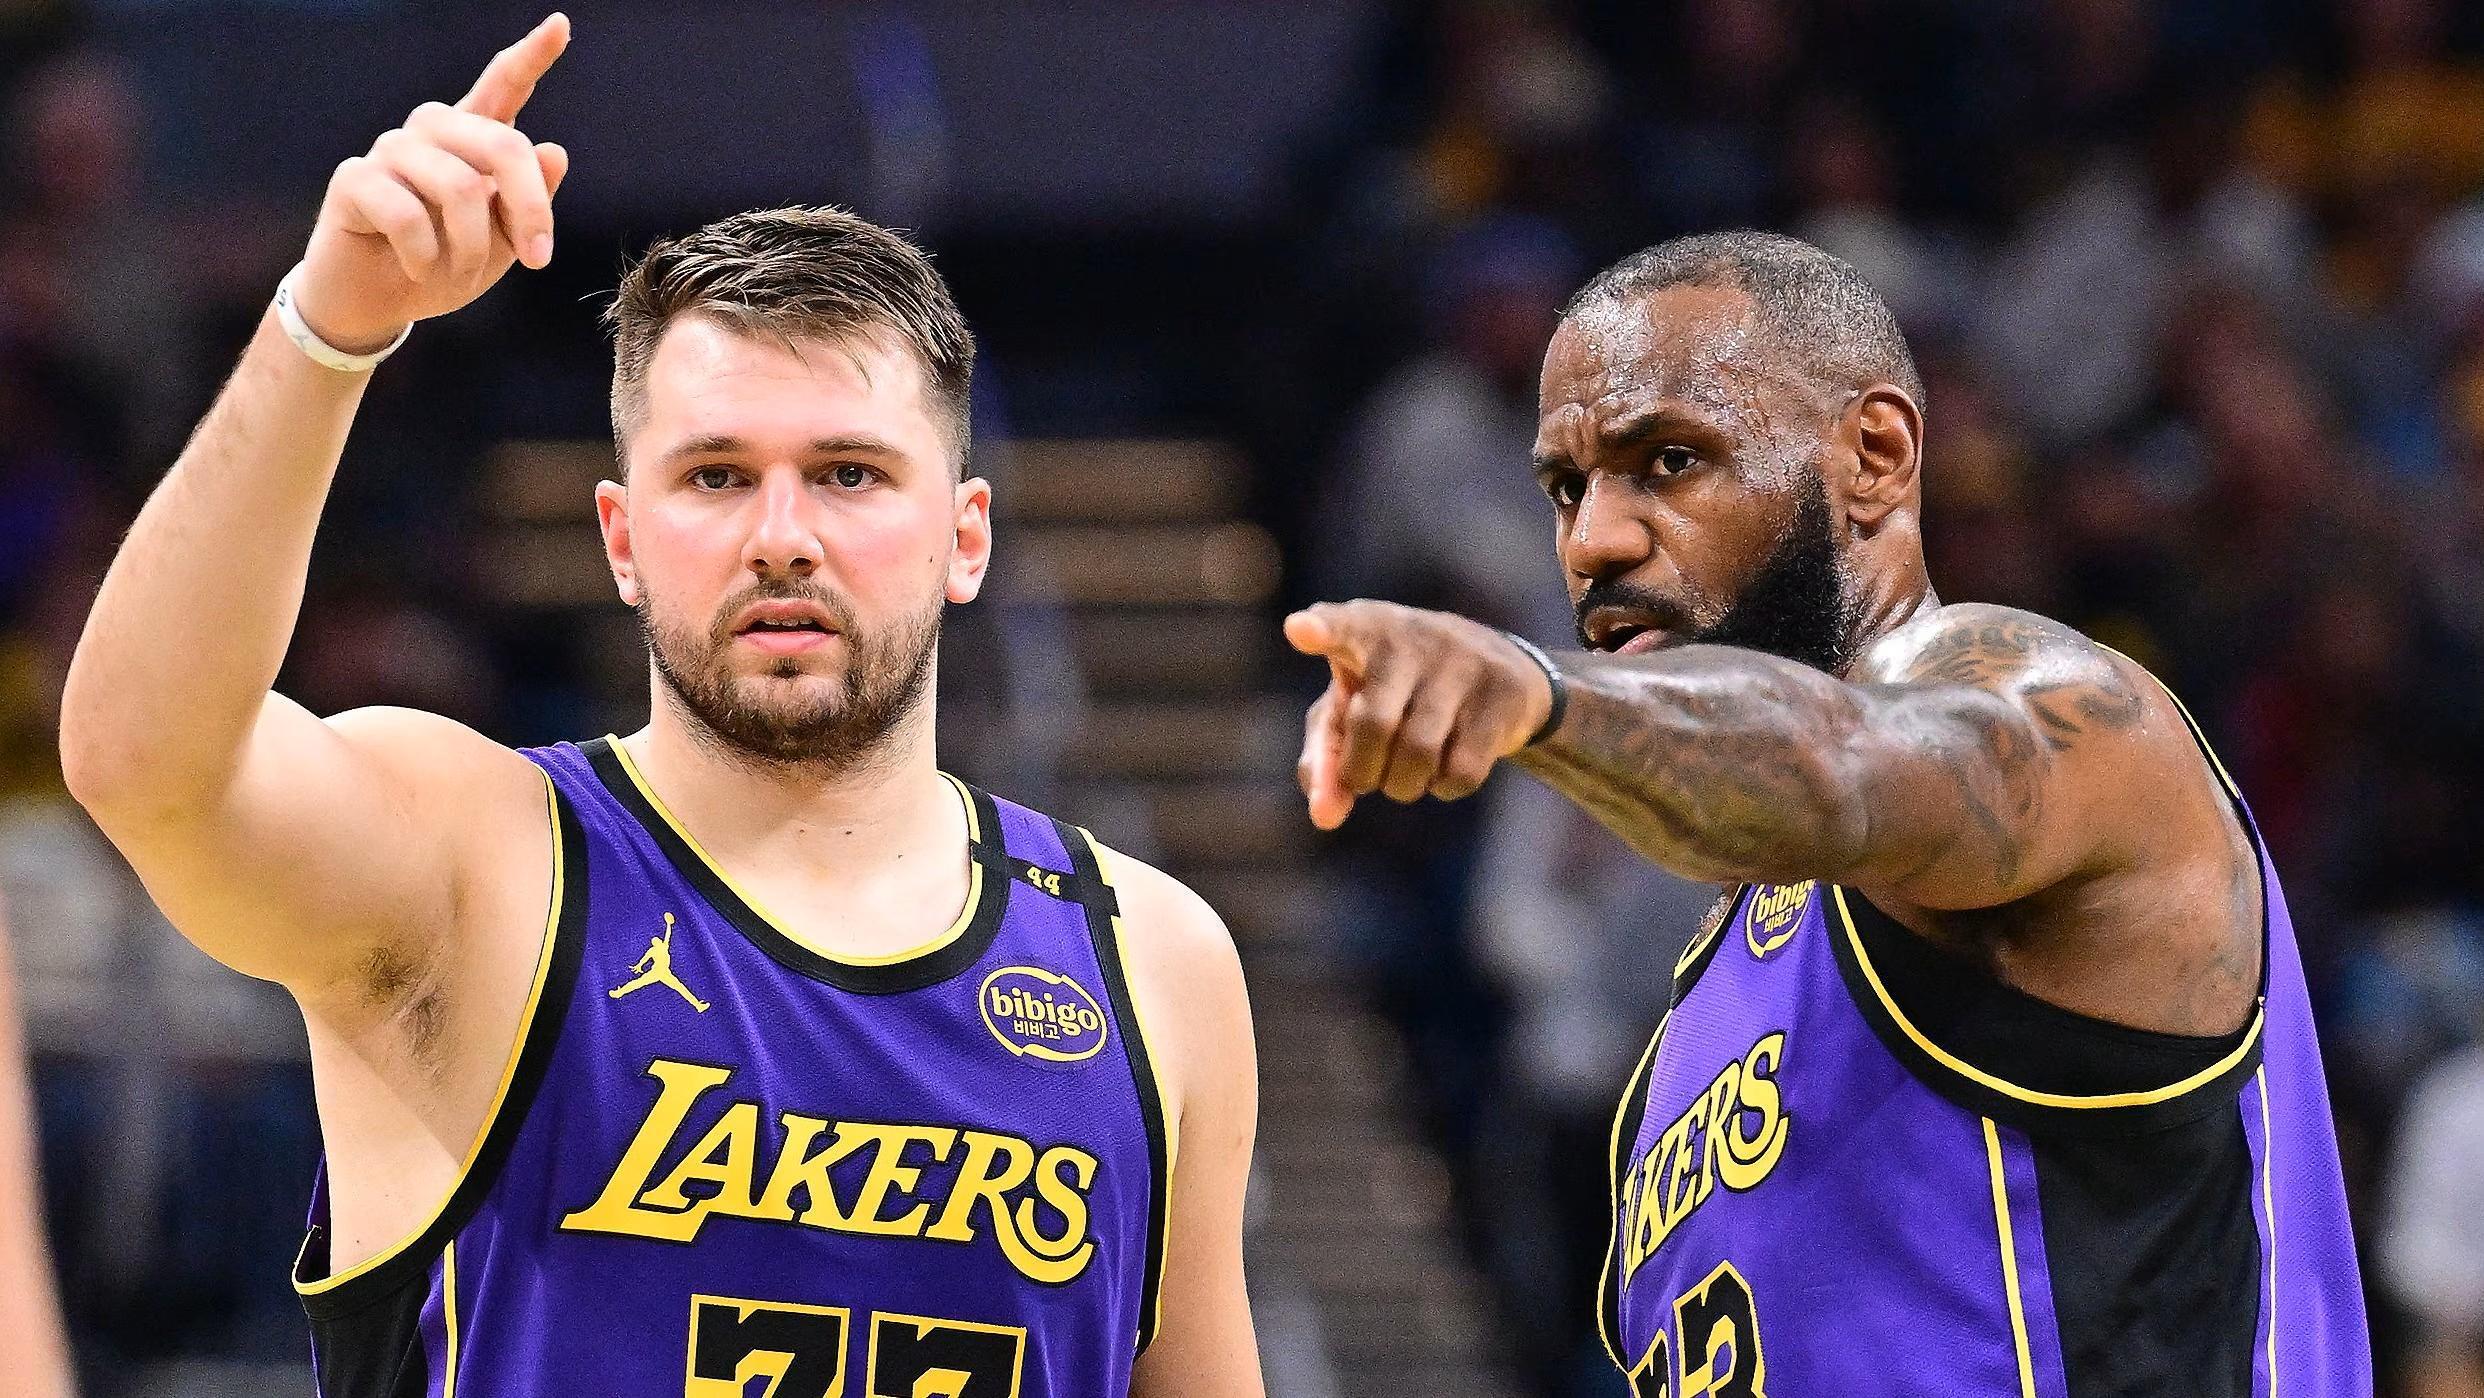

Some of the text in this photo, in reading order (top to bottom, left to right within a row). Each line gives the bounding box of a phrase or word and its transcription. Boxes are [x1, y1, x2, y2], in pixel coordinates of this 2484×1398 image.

[1026, 866, 1061, 896] 44
[990, 986, 1099, 1037] bibigo
[1014, 1020, 1061, 1041] 비비고
[558, 1058, 1098, 1286] LAKERS
[684, 1293, 1028, 1398] 77
